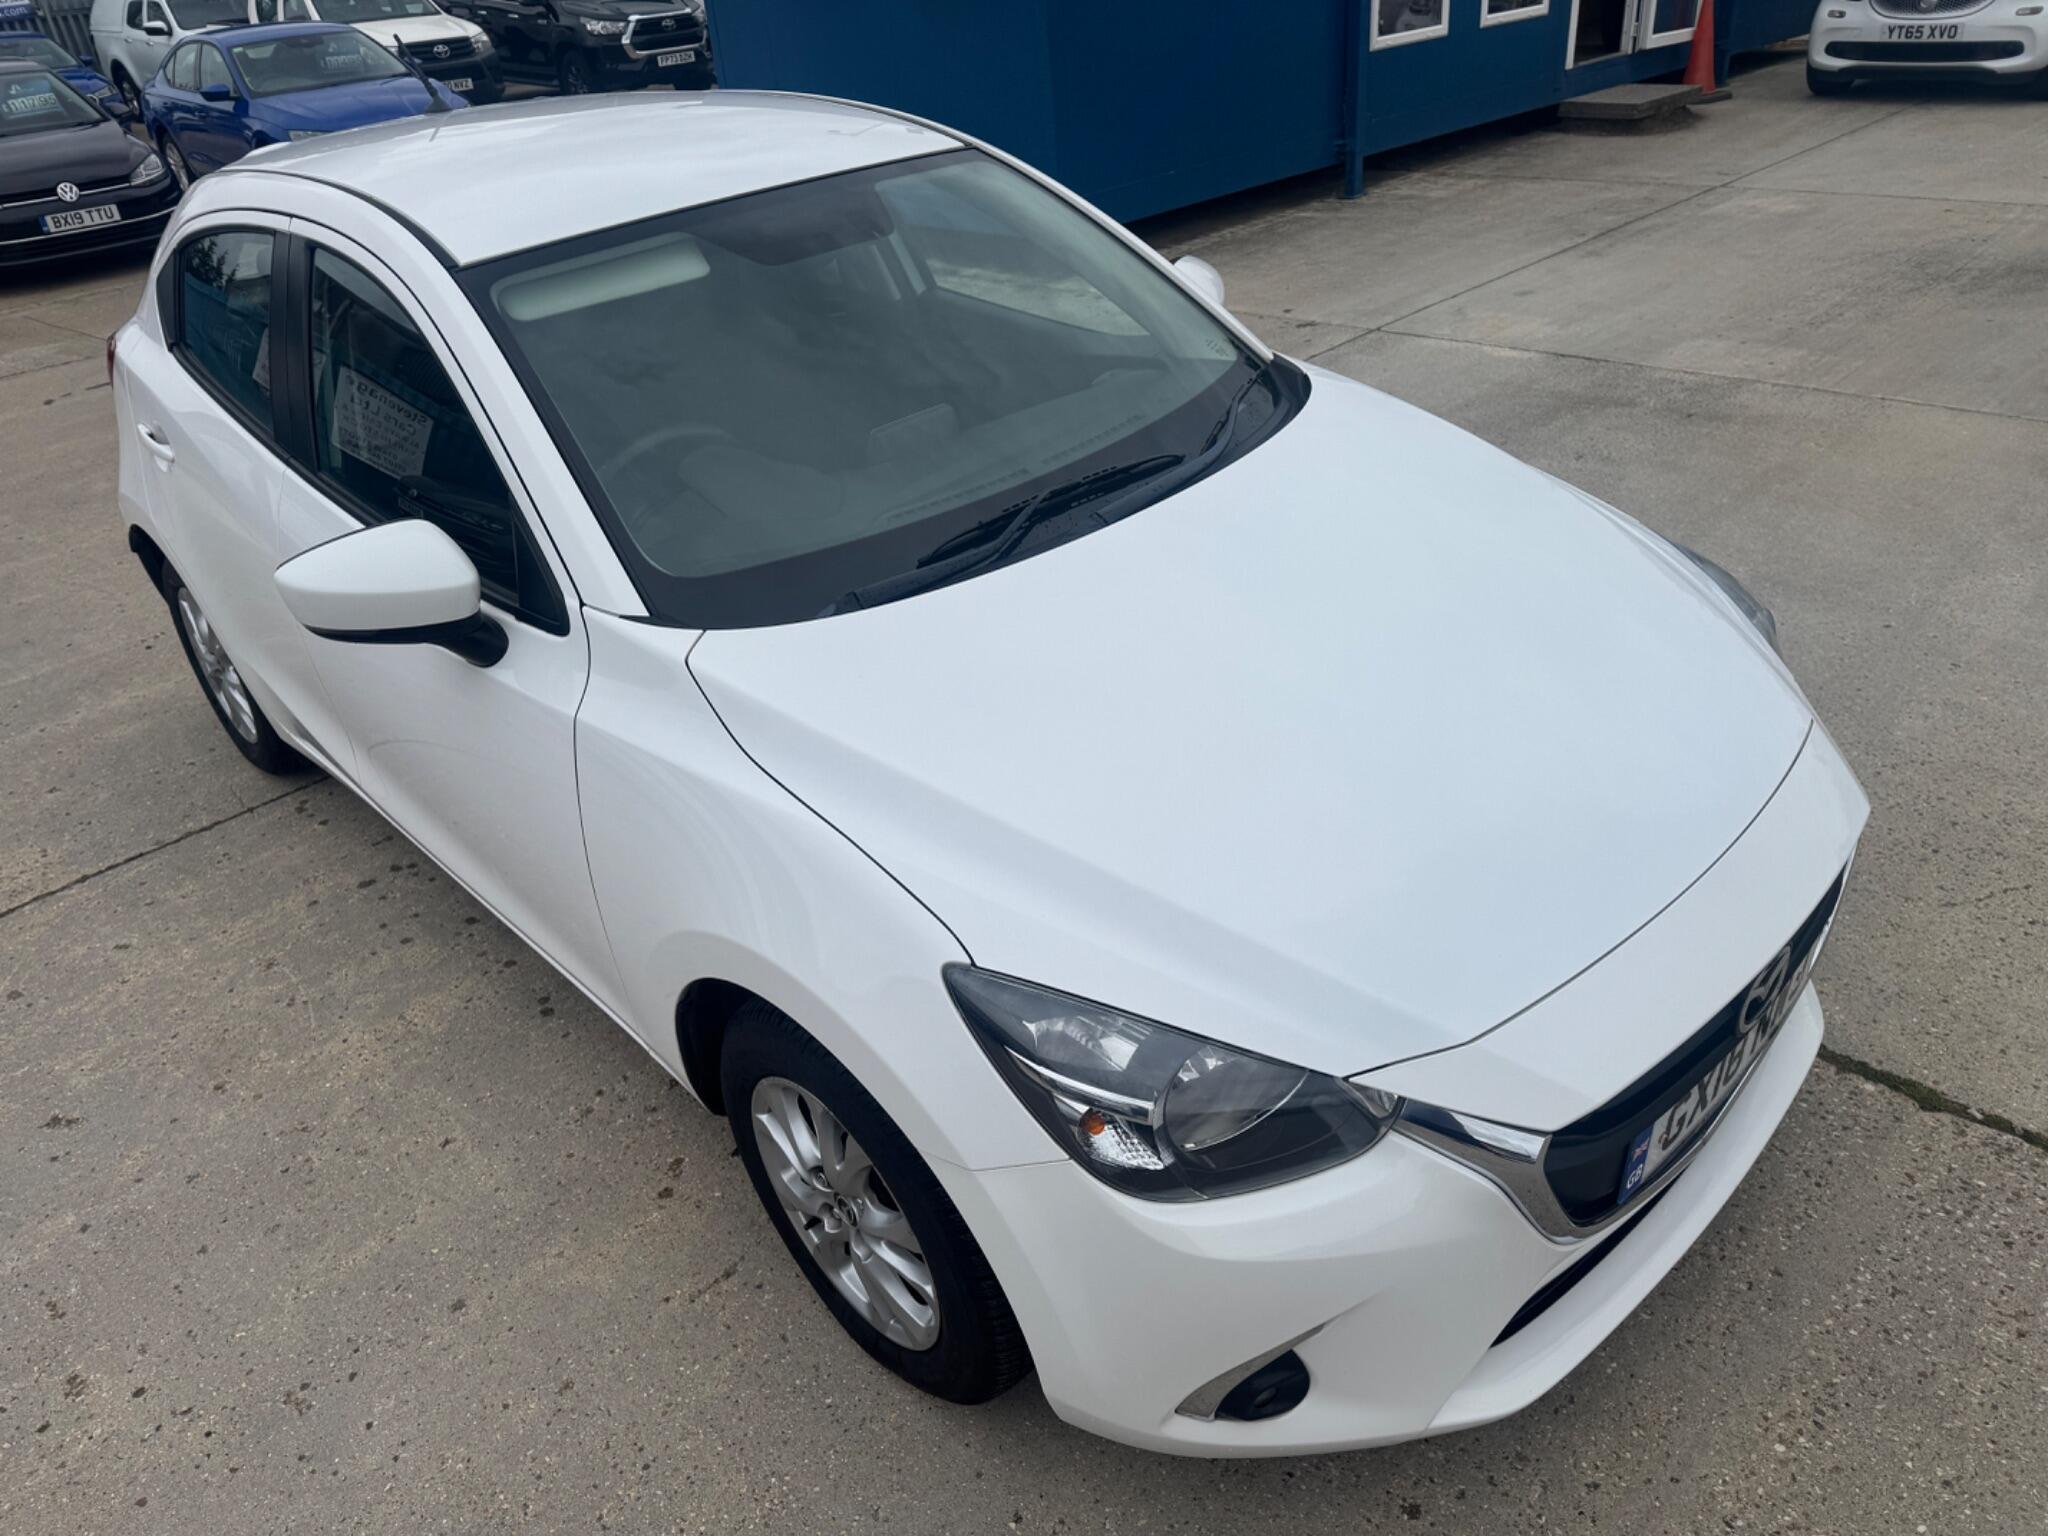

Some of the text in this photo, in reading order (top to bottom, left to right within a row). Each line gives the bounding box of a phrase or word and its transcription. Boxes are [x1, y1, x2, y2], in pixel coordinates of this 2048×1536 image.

[1888, 24, 1959, 39] YT65 XVO
[51, 206, 114, 229] BX19 TTU
[1626, 1164, 1645, 1189] GB
